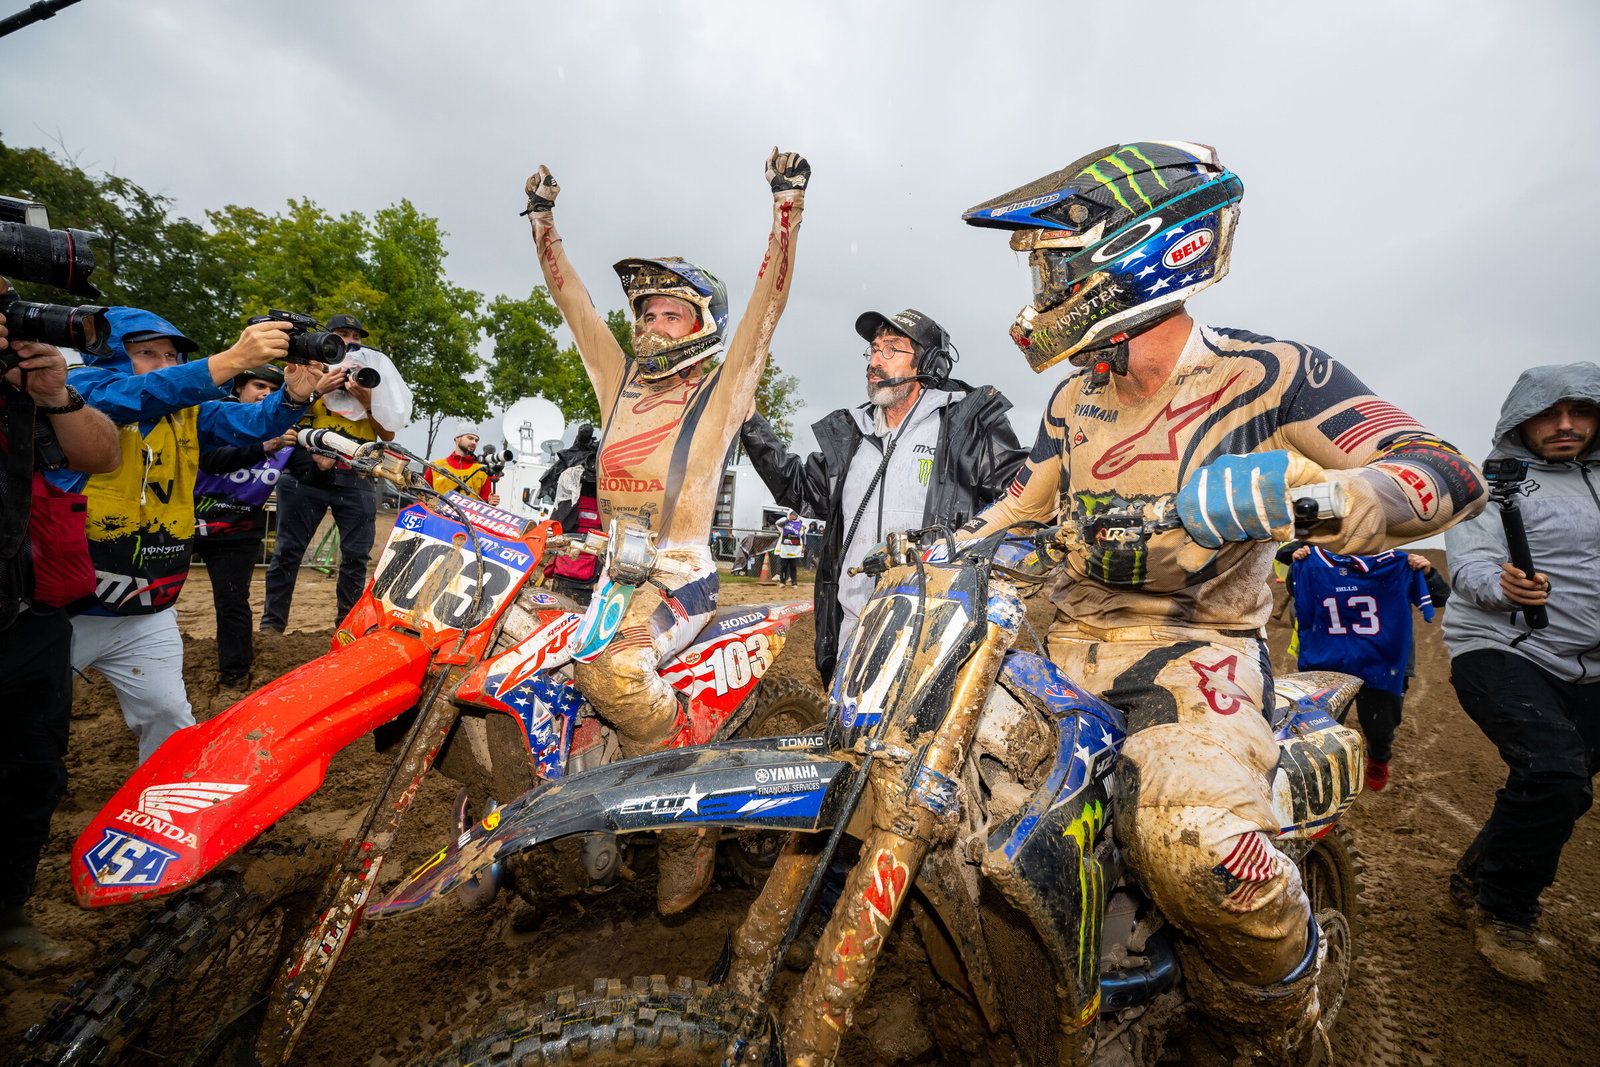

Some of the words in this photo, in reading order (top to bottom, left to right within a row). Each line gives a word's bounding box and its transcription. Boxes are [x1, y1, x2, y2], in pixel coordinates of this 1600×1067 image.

[1171, 235, 1208, 263] BELL
[1065, 302, 1120, 336] ENERGY
[1079, 403, 1119, 423] YAMAHA
[1400, 448, 1478, 494] YAMAHA
[598, 477, 665, 493] HONDA
[214, 502, 251, 512] MONSTER
[449, 493, 523, 528] RENTHAL
[372, 534, 510, 630] 103
[391, 611, 430, 630] HOA
[546, 613, 581, 638] 450R
[718, 611, 767, 631] HONDA
[1322, 595, 1380, 635] 13
[705, 633, 775, 697] 103
[1308, 716, 1330, 727] TOMAC
[779, 736, 824, 747] TOMAC
[768, 765, 819, 781] YAMAHA
[758, 784, 791, 795] FINANCIAL
[792, 782, 820, 793] SERVICES
[116, 808, 199, 849] HONDA
